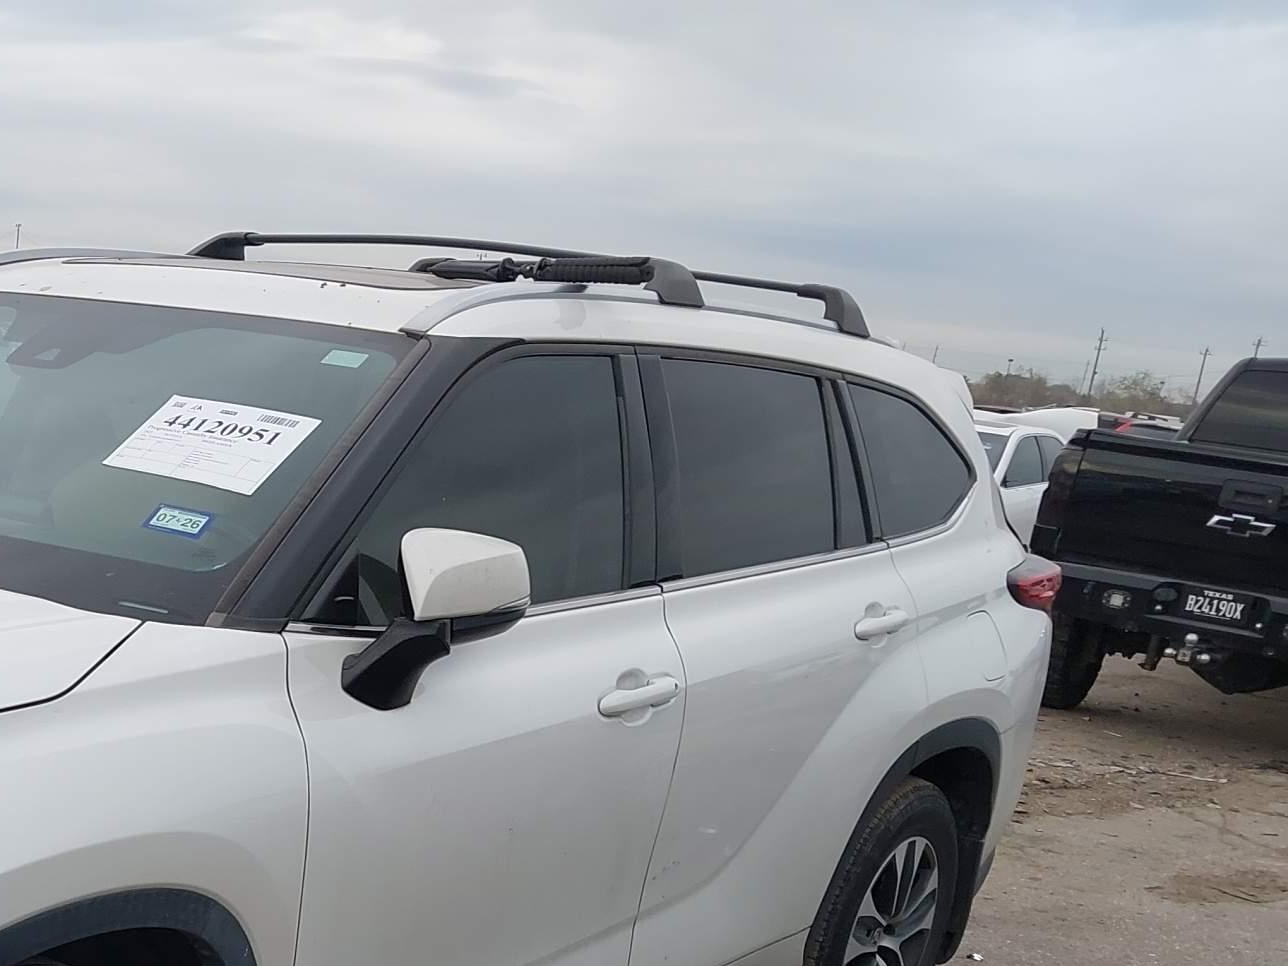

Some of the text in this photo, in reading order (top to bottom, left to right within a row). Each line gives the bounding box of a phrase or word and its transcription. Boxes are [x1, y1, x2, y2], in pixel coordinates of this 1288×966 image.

[163, 414, 282, 446] 44120951
[156, 513, 177, 524] 07
[180, 518, 202, 529] 26
[1203, 590, 1234, 600] TEXAS
